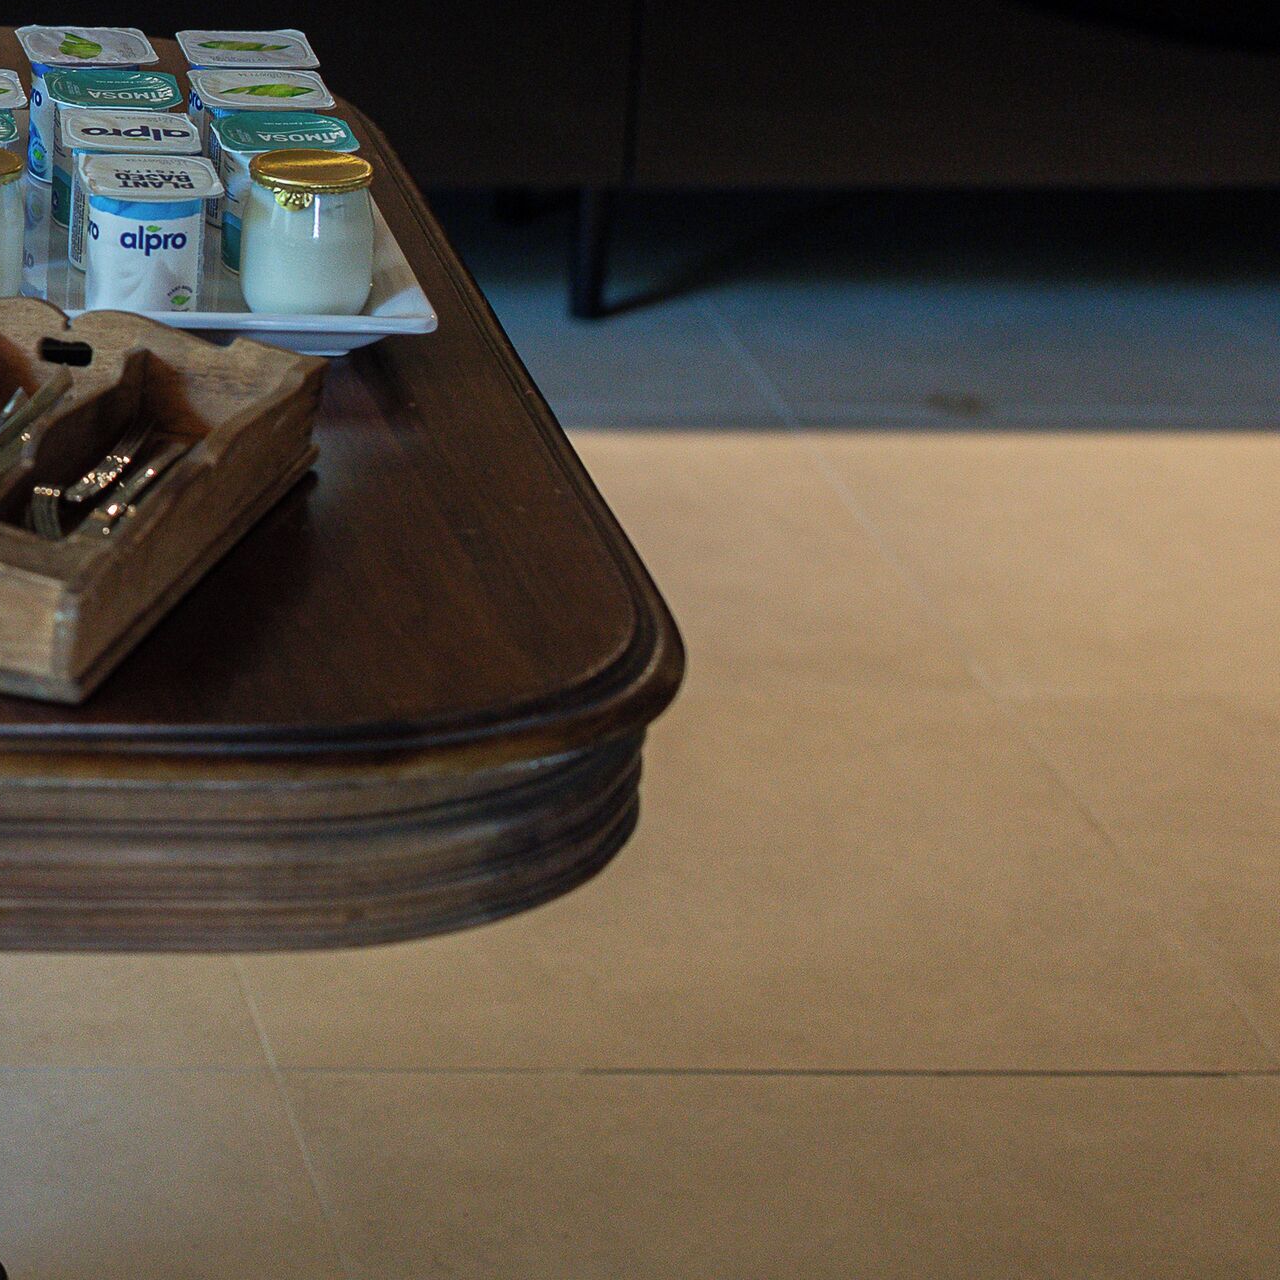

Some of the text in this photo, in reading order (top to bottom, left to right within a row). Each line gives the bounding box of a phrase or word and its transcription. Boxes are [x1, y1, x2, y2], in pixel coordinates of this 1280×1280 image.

[81, 126, 191, 142] alpro
[257, 130, 347, 144] MIMOSA
[115, 173, 192, 182] BASED
[118, 180, 195, 189] PLANT
[120, 225, 187, 256] alpro
